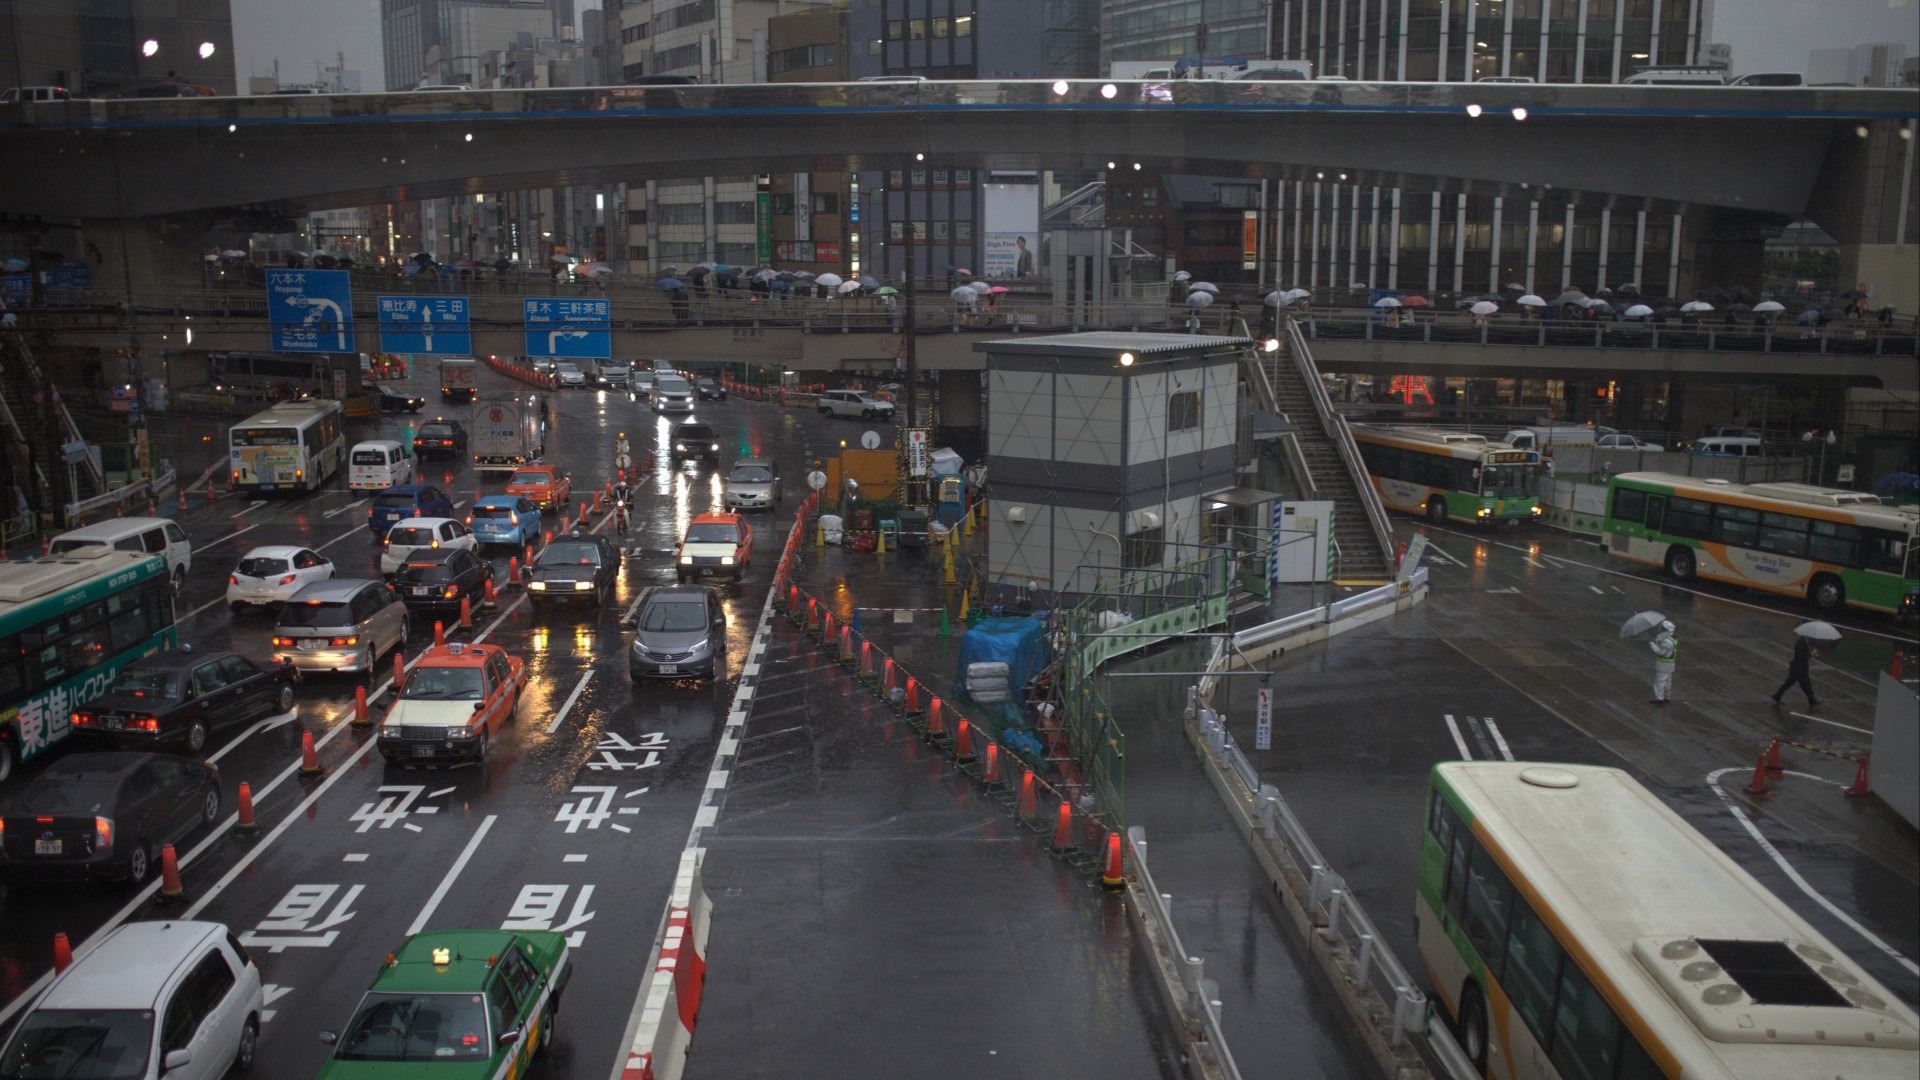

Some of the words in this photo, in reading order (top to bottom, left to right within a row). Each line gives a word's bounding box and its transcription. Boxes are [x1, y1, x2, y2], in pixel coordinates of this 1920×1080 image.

[986, 240, 1002, 249] High
[1003, 241, 1016, 249] Five
[270, 272, 306, 285] 六本木
[274, 285, 304, 294] Roppongi
[382, 300, 417, 313] 恵比寿
[526, 301, 552, 313] 厚木
[558, 301, 607, 315] 三軒茶屋
[442, 313, 457, 321] Mita
[281, 327, 318, 341] 三宅坂
[1778, 558, 1791, 568] Bus
[117, 574, 128, 586] STEP
[128, 571, 138, 581] BUS
